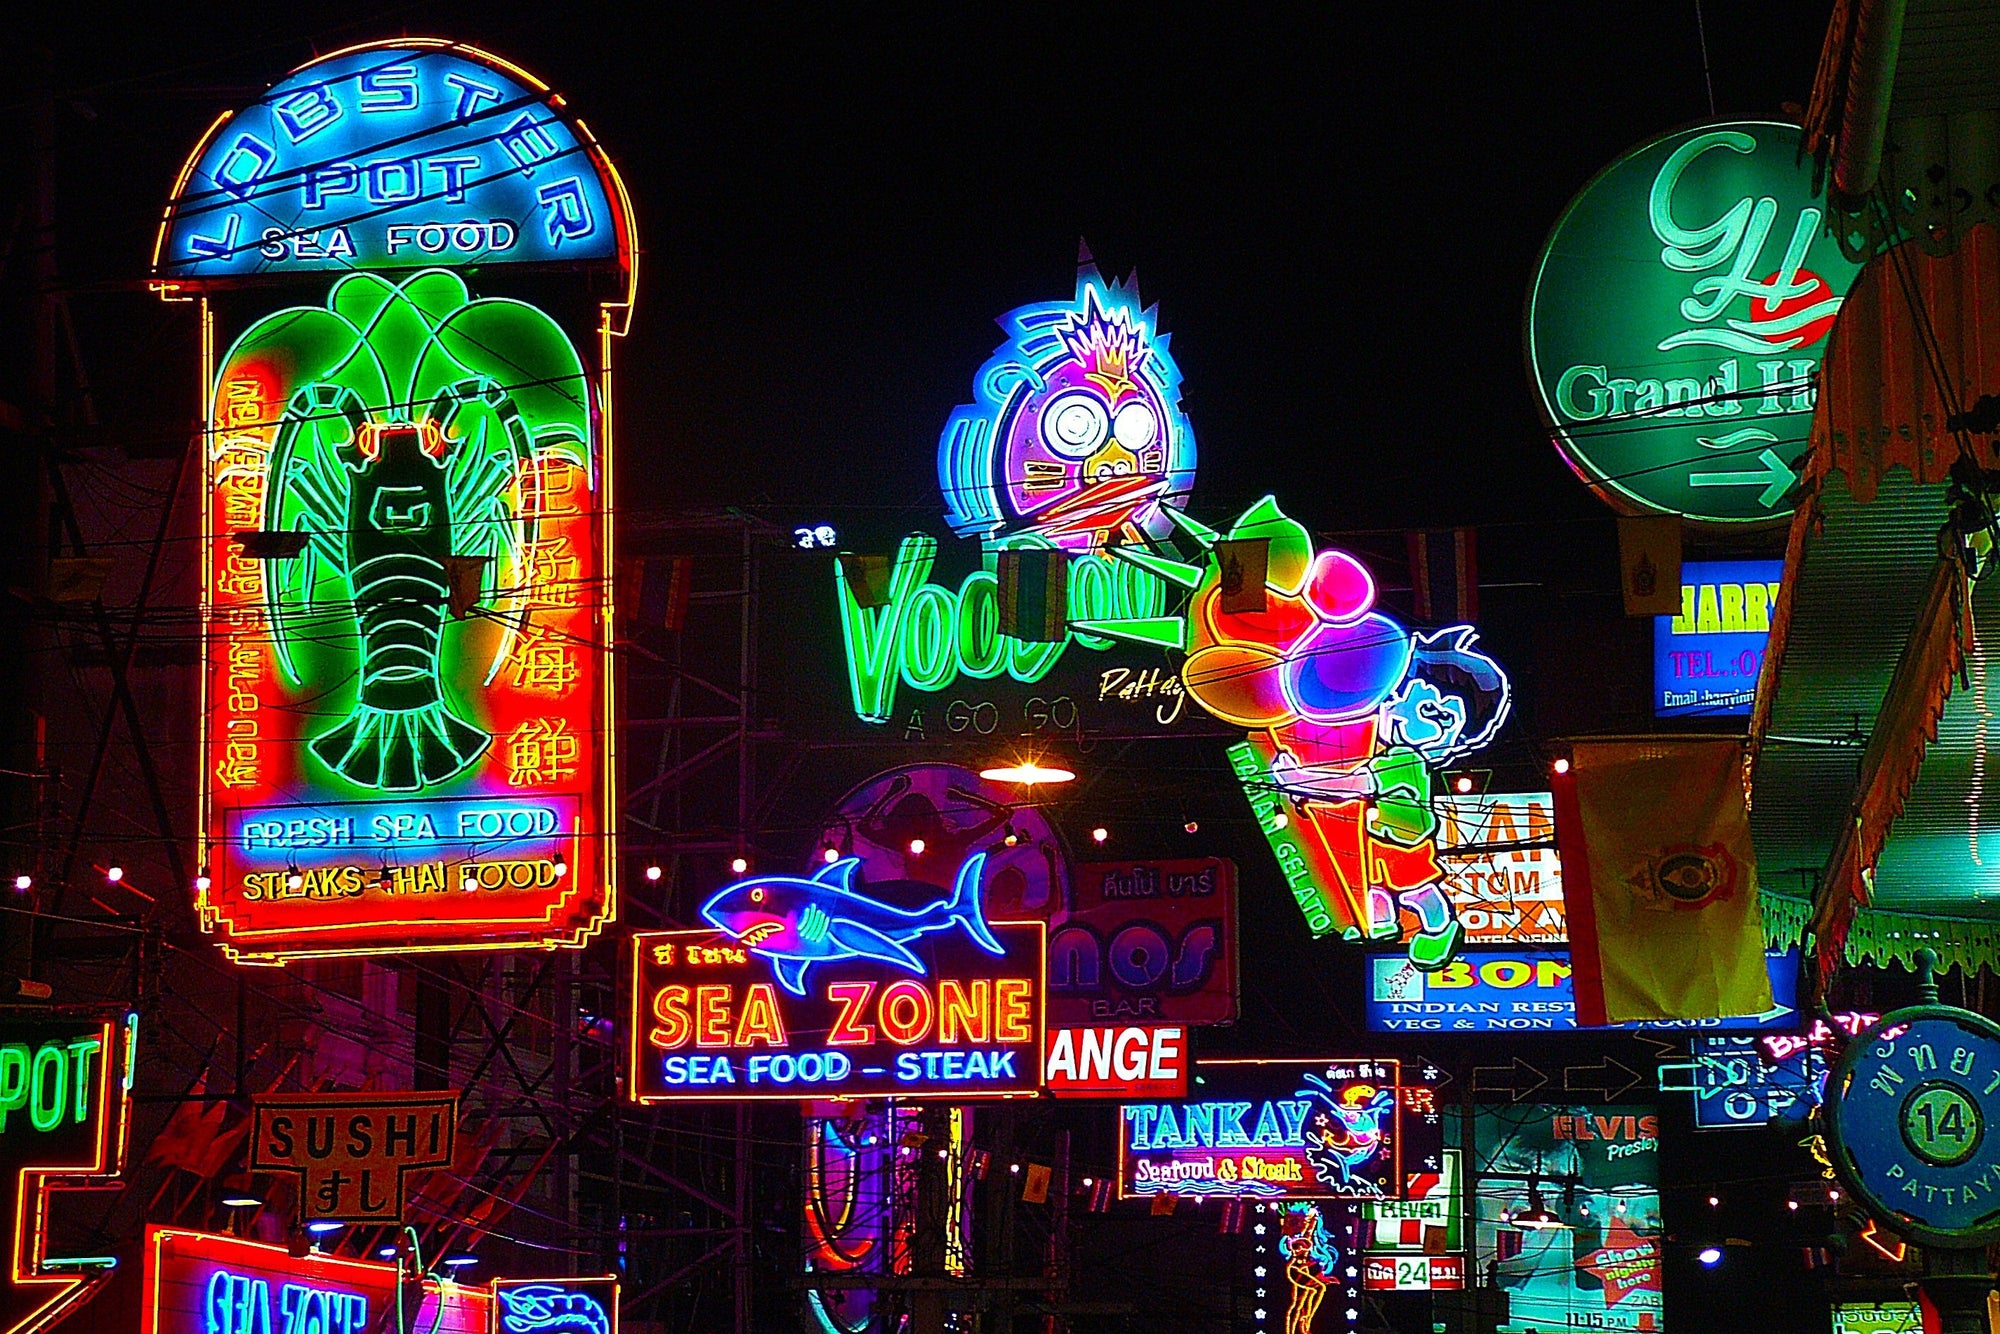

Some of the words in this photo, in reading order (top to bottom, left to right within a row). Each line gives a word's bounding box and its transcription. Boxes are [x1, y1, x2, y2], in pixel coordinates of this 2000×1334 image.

[182, 64, 596, 262] LOBSTER
[300, 156, 480, 210] POT
[260, 224, 357, 260] SEA
[385, 218, 518, 256] FOOD
[1555, 359, 1738, 421] Grand
[1756, 358, 1817, 416] H
[946, 700, 999, 734] GO
[243, 820, 353, 850] FRESH
[457, 808, 559, 839] FOOD
[242, 865, 362, 901] STEAKS
[457, 859, 556, 892] FOOD
[650, 981, 787, 1049] SEA
[827, 978, 1033, 1048] ZONE
[1092, 998, 1155, 1017] BAR
[1383, 1019, 1442, 1031] VEG
[1452, 1019, 1476, 1031] &
[1486, 1018, 1552, 1030] NON
[1391, 1002, 1500, 1014] INDIAN
[664, 1056, 736, 1084] SEA
[748, 1053, 852, 1082] FOOD
[897, 1051, 1017, 1080] STEAK
[1048, 1028, 1179, 1081] ANGE
[0, 1040, 100, 1133] POT
[268, 1114, 441, 1159] SUSHI
[1126, 1101, 1312, 1150] TANKAY
[1553, 1115, 1660, 1141] ELVIS
[1917, 1103, 1966, 1142] 14
[1135, 1157, 1215, 1183] Seafood
[1216, 1158, 1239, 1182] &
[1240, 1156, 1303, 1182] Steak
[1607, 1136, 1659, 1162] Presley
[318, 1170, 387, 1212] すし
[1398, 1261, 1428, 1285] 24
